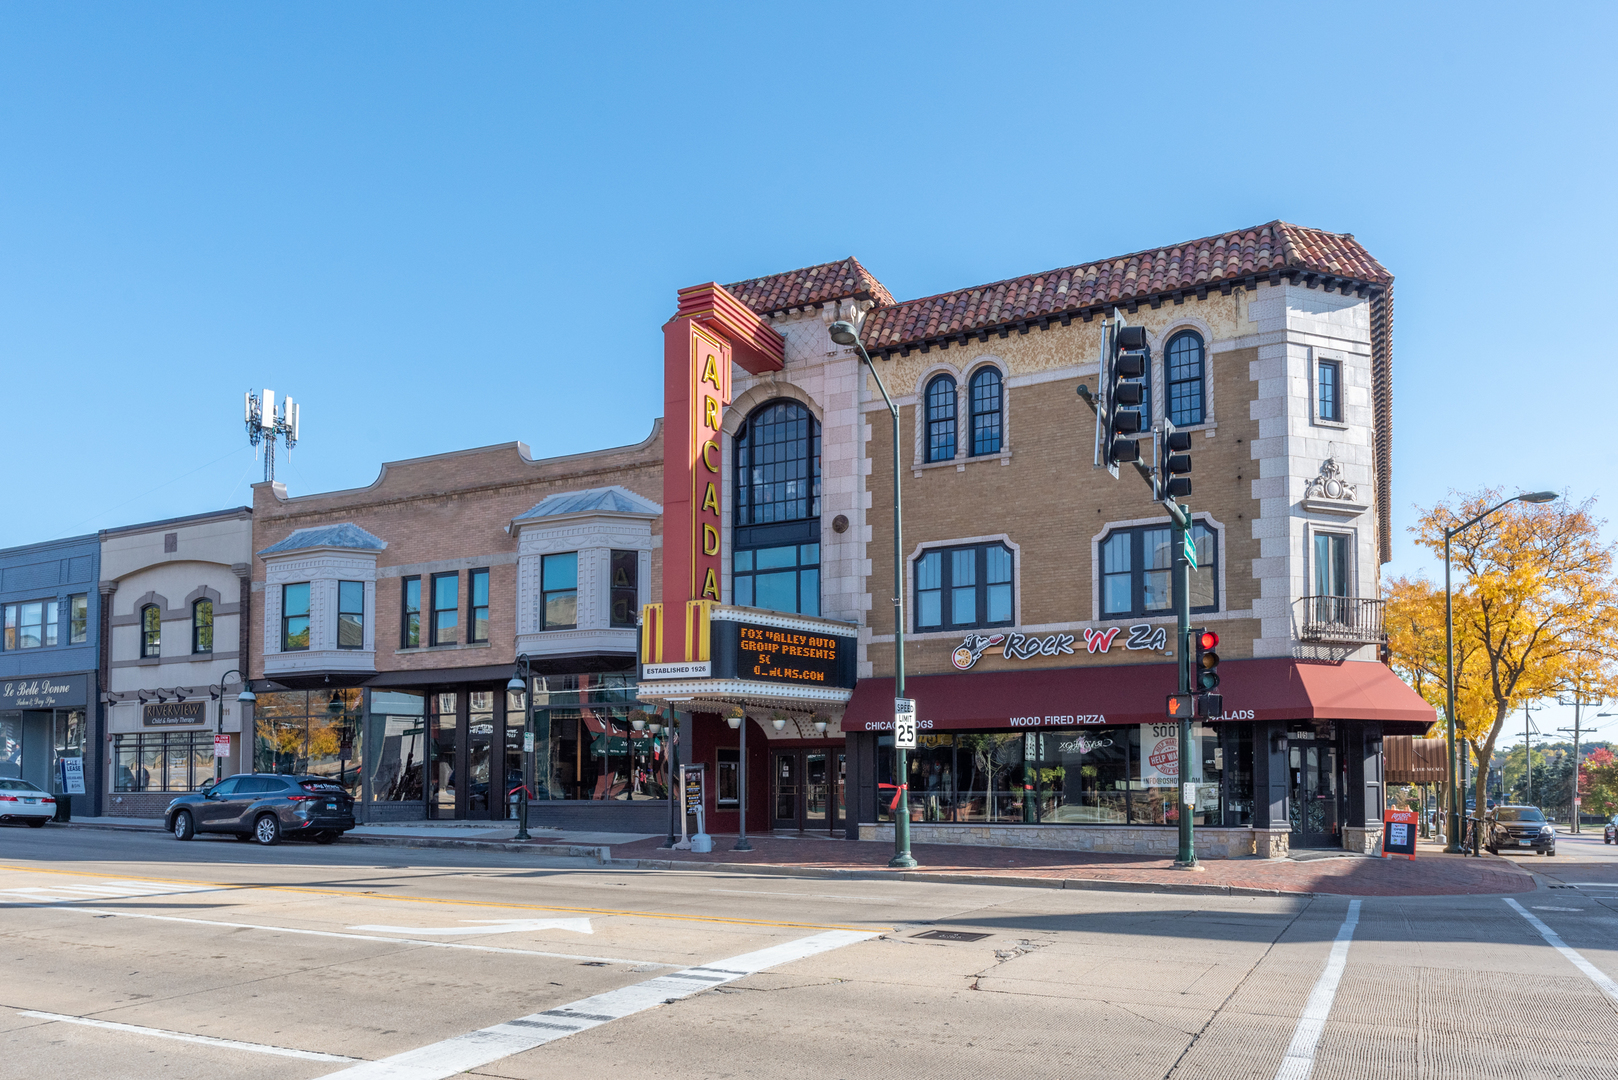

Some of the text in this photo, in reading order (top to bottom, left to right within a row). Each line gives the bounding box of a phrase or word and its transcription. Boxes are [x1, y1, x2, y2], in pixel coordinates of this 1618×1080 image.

[701, 353, 721, 602] ARCADA
[741, 627, 763, 640] FOX
[808, 636, 836, 649] AUTO
[1003, 632, 1075, 660] ROCK
[1126, 624, 1167, 650] ZA
[740, 640, 836, 660] GROUP PRESENTS
[646, 665, 707, 675] ESTABLISHED 1926
[2, 679, 71, 698] Le Belle Donne
[45, 696, 56, 707] Spa
[896, 703, 915, 713] SPEED
[147, 703, 200, 717] RIVERVIEW
[166, 716, 179, 724] Family
[179, 716, 196, 724] Therapy
[865, 719, 934, 730] CHICA OGS
[898, 714, 912, 723] LIMIT
[1009, 714, 1107, 727] WOOD FIRED PIZZA
[897, 724, 914, 743] 25
[1153, 725, 1179, 738] SOO
[1150, 754, 1167, 765] HELP
